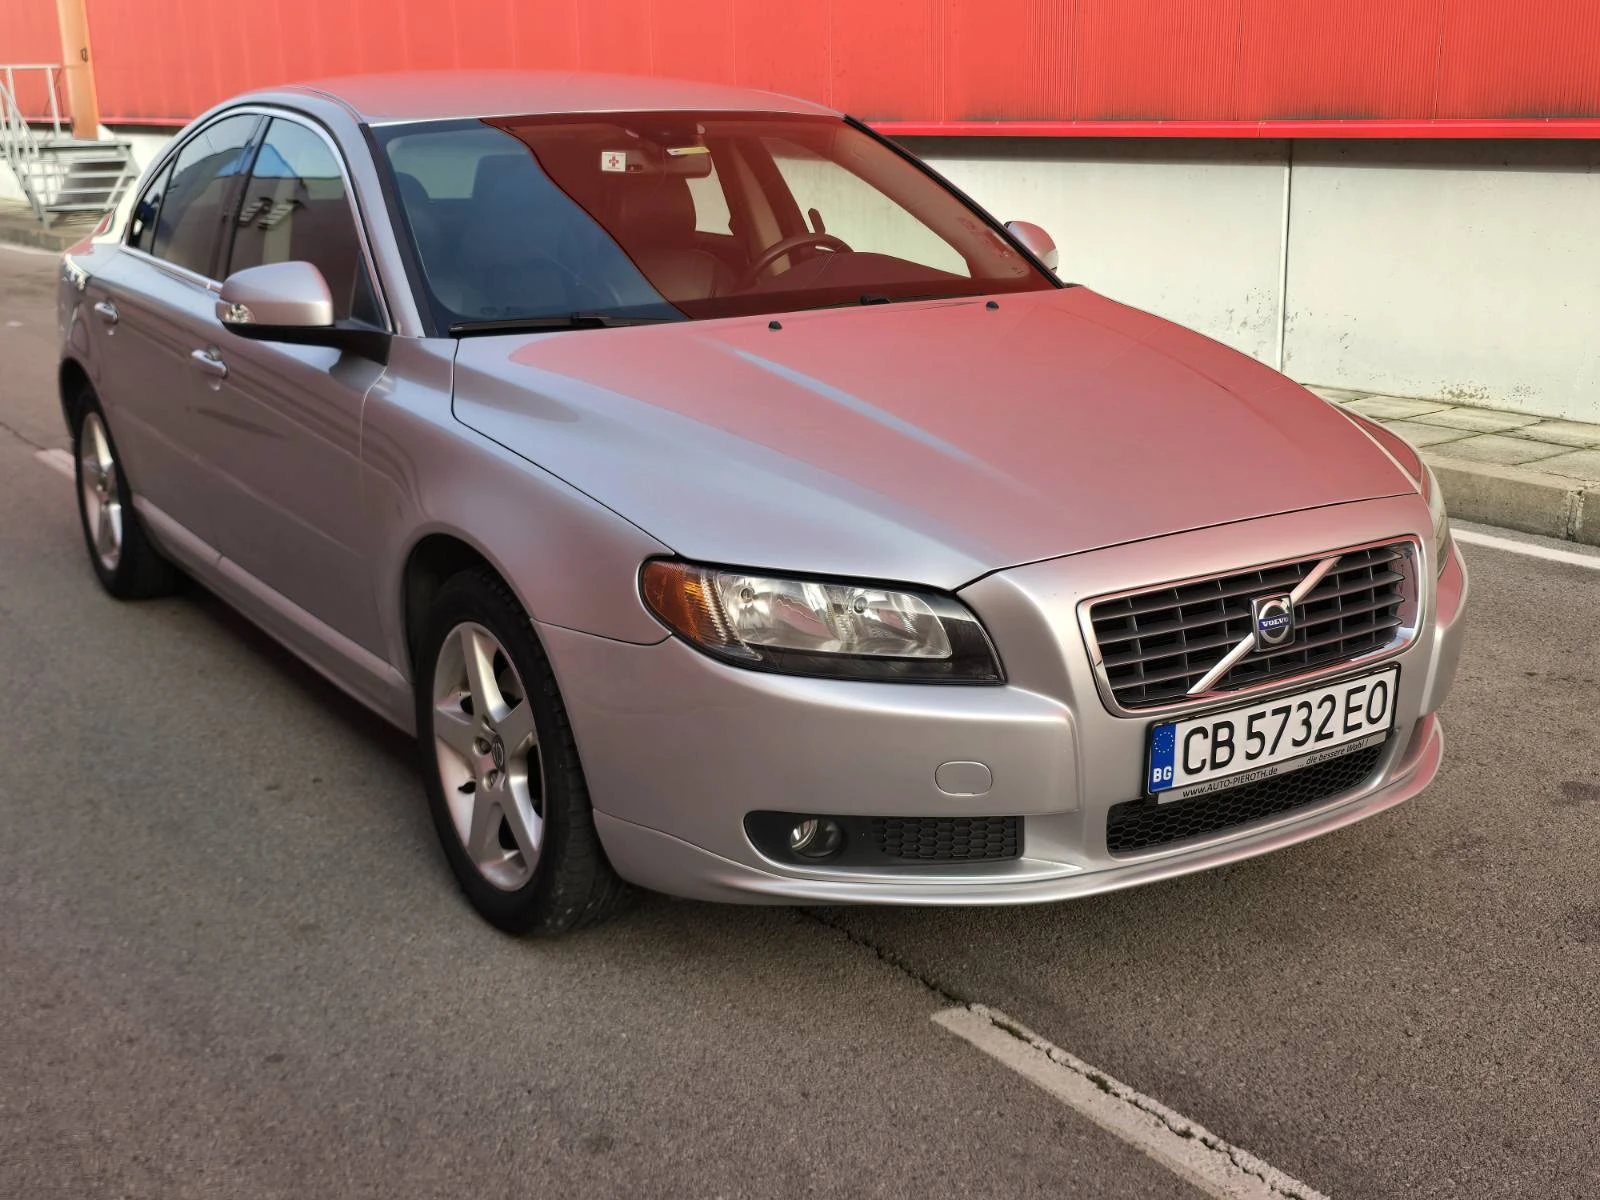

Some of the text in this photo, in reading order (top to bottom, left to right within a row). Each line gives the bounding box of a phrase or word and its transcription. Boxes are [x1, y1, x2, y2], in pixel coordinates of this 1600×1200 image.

[1262, 617, 1288, 627] VOLVO
[1245, 694, 1337, 760] 5732
[1319, 748, 1345, 761] bessere
[1153, 766, 1172, 783] BG
[1182, 766, 1278, 798] www.AUTO-PIEROTH.de
